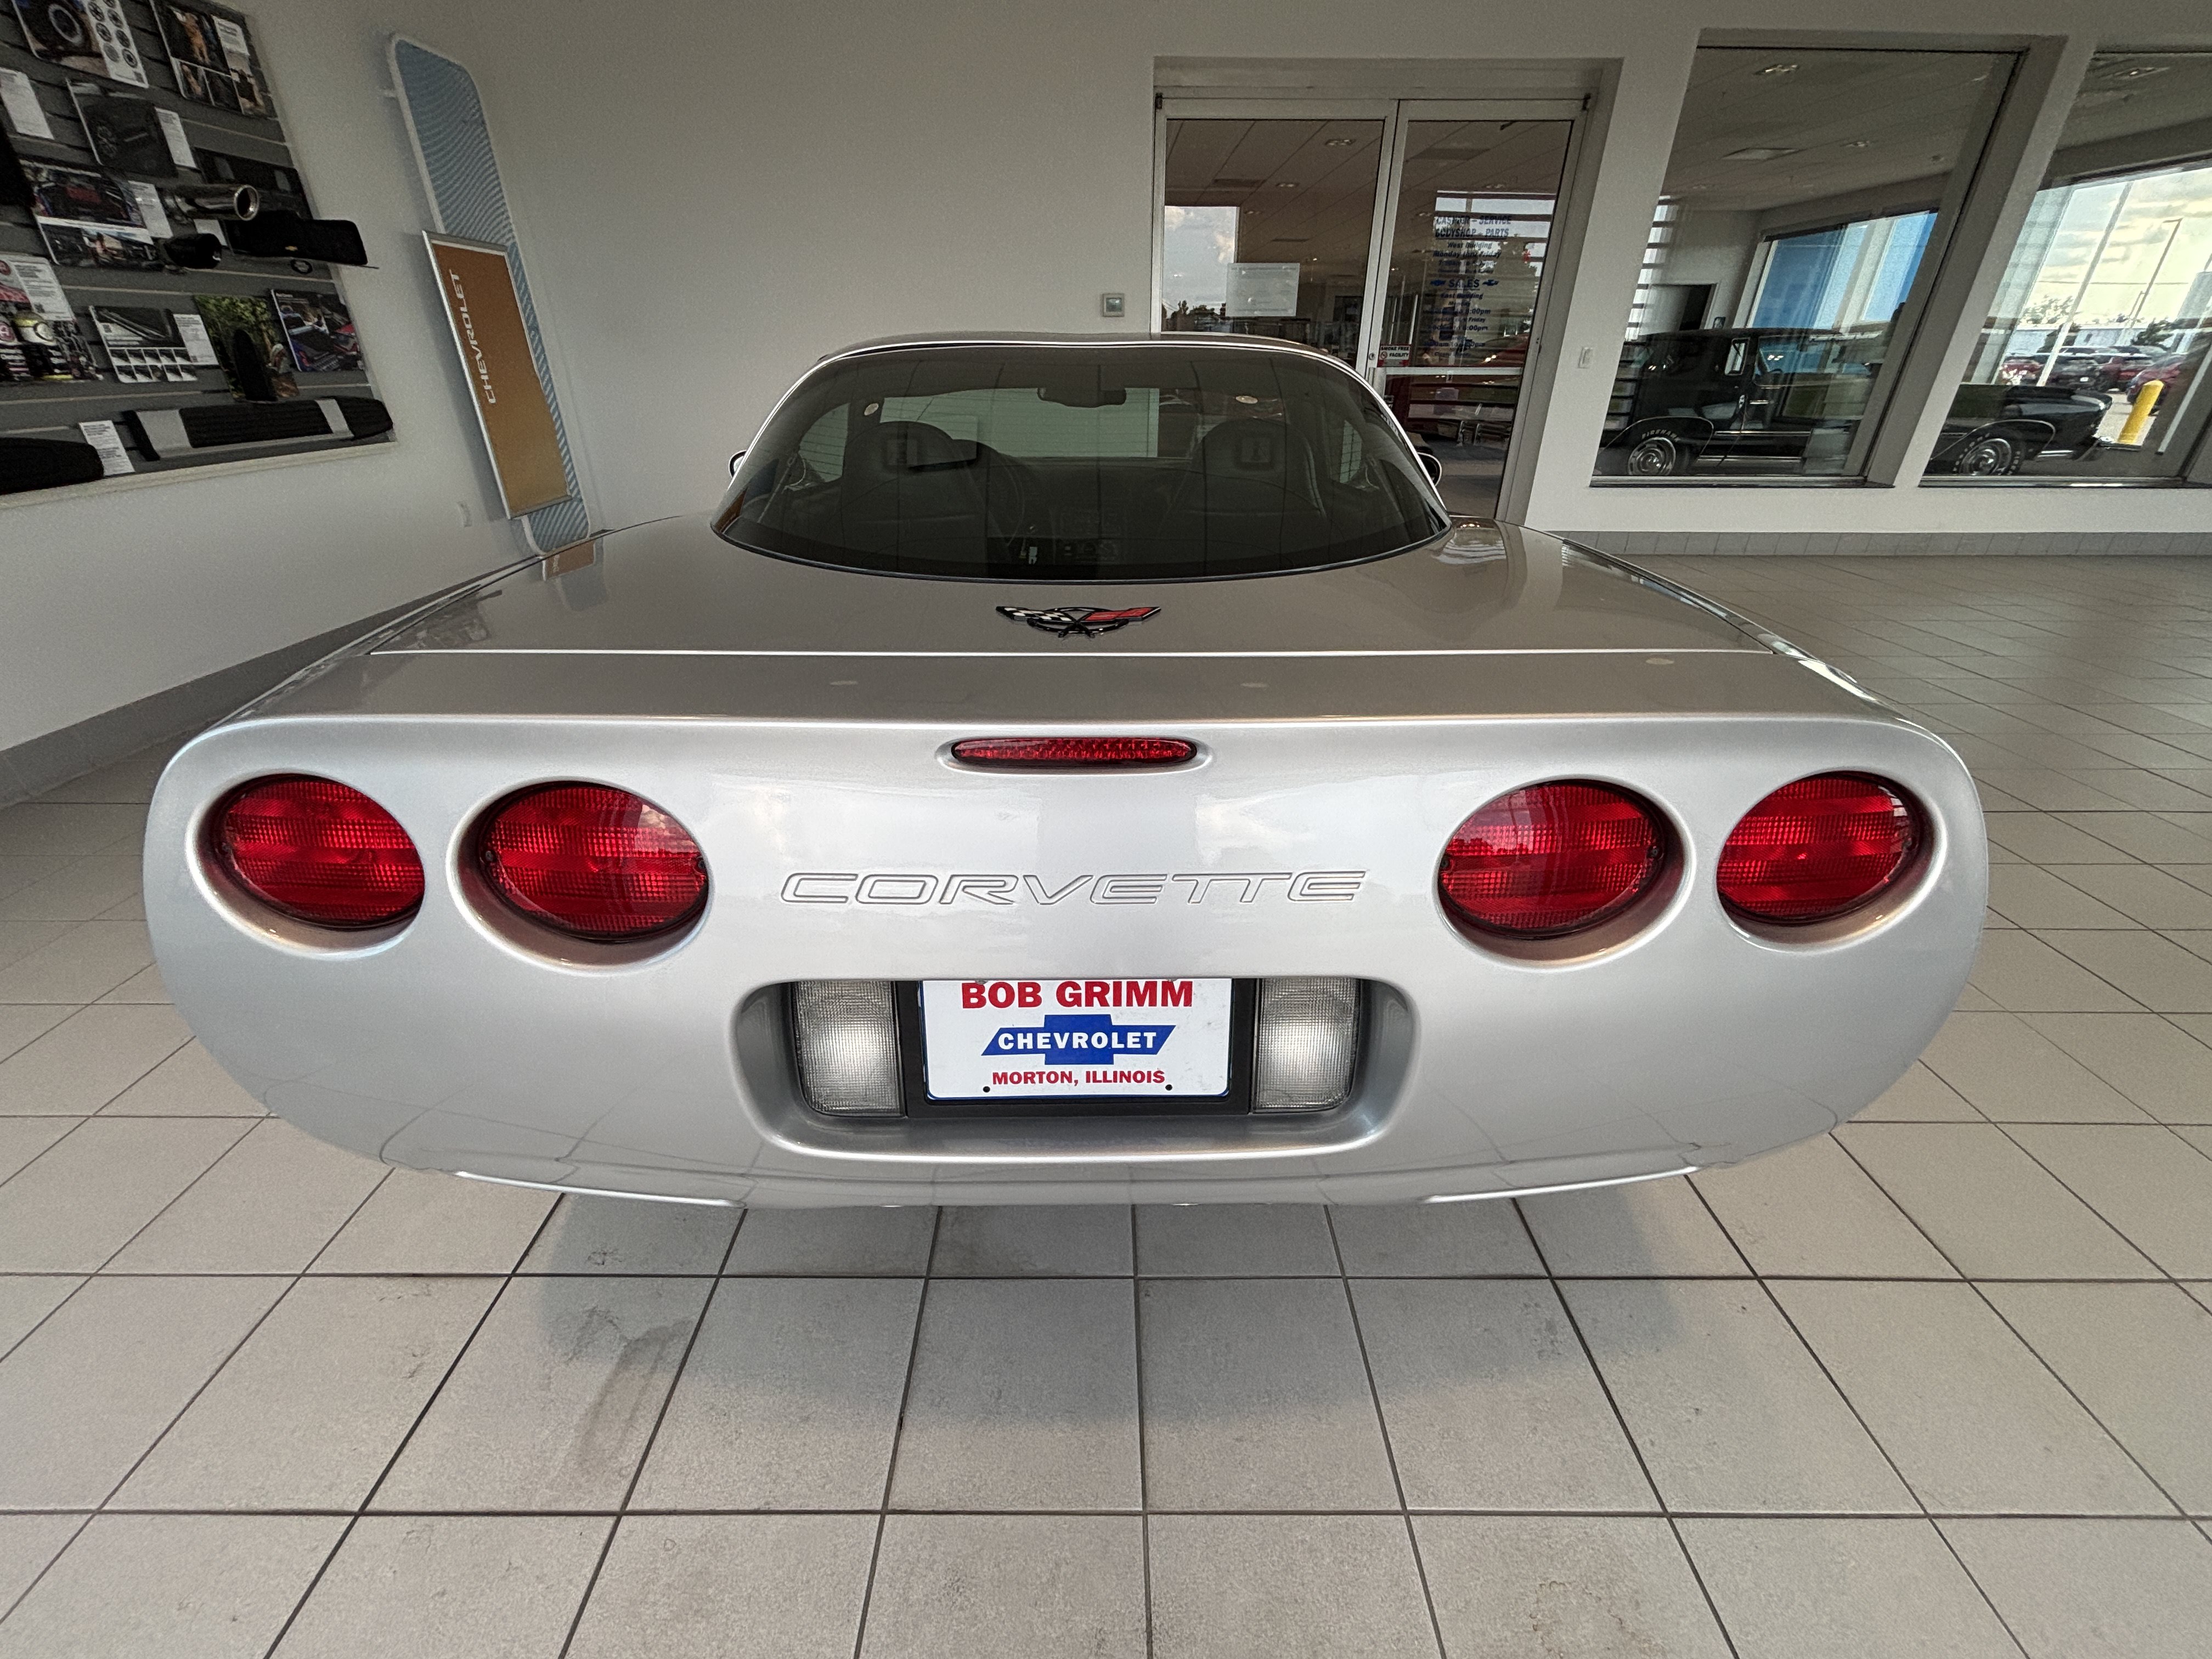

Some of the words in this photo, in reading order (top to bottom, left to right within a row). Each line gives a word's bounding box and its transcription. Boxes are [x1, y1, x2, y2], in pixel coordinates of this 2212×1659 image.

[1436, 216, 1470, 225] CASHIER
[1479, 215, 1512, 225] SERVICE
[1435, 228, 1476, 238] BODYSHOP
[1485, 228, 1509, 238] PARTS
[1448, 279, 1480, 288] SALES
[449, 269, 496, 404] CHEVROLET
[781, 871, 1367, 905] CORVETTE
[962, 981, 1042, 1009] BOB
[1056, 981, 1193, 1008] GRIMM
[998, 1032, 1157, 1050] CHEVROLET
[992, 1071, 1079, 1087] MORTON,
[1086, 1070, 1165, 1084] ILLINOIS
